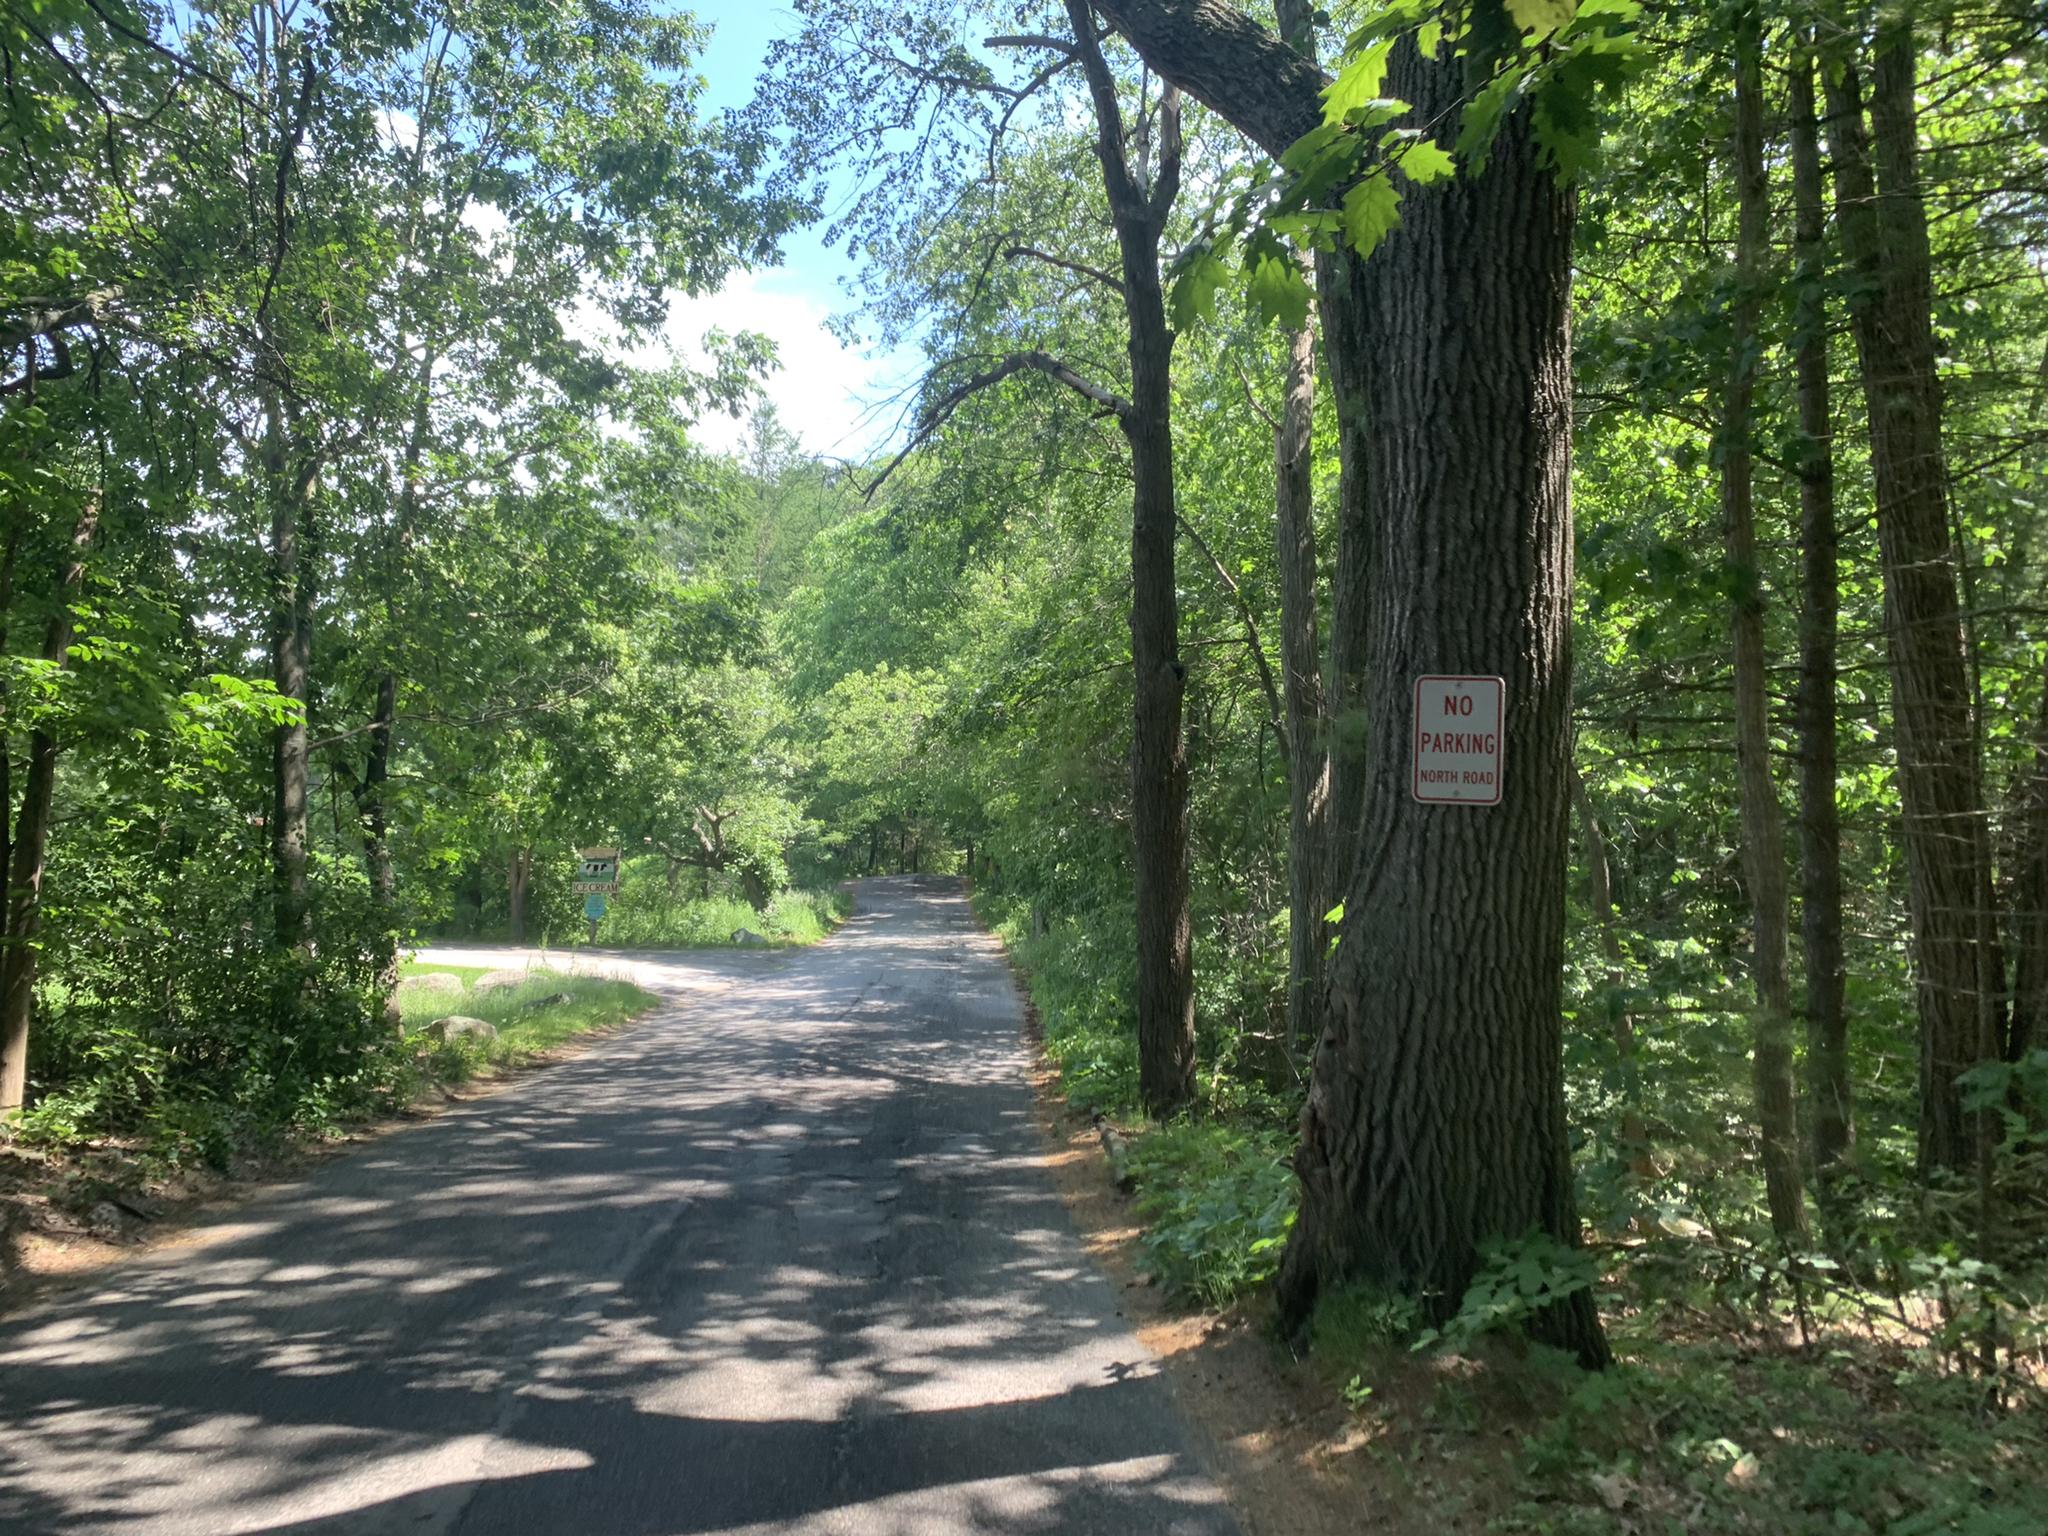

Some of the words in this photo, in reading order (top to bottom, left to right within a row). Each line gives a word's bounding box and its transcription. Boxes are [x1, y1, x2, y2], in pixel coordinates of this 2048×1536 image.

[1444, 695, 1473, 716] NO
[1421, 732, 1495, 755] PARKING
[1420, 770, 1458, 784] NORTH
[1463, 771, 1494, 785] ROAD
[574, 883, 588, 892] ICE
[588, 883, 618, 892] CREAM
